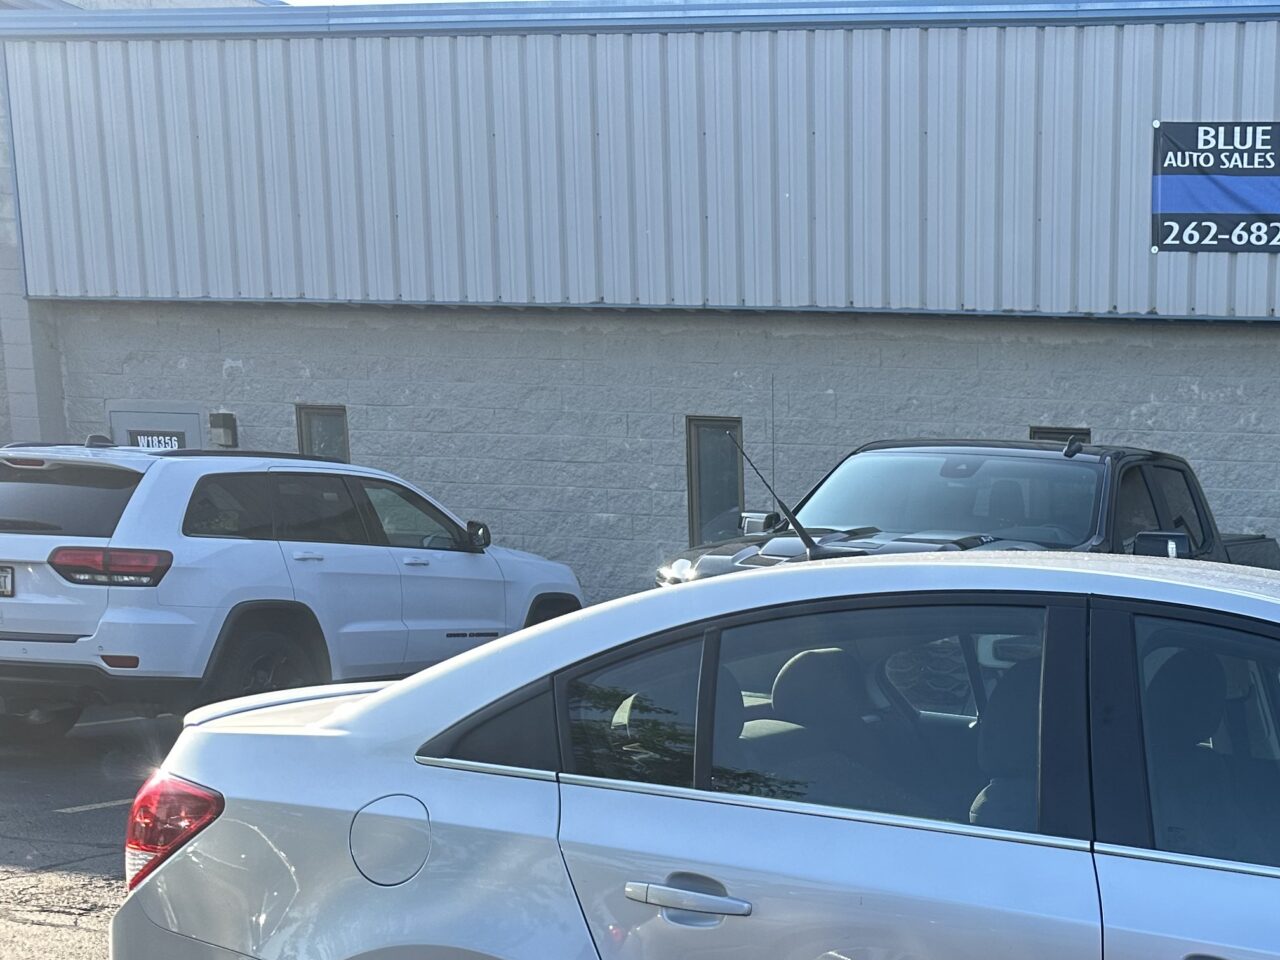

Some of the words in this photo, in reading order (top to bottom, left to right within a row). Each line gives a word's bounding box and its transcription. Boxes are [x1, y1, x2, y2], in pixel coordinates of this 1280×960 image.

[1197, 126, 1272, 150] BLUE
[1163, 151, 1215, 168] AUTO
[1219, 152, 1275, 169] SALES
[137, 435, 178, 450] W18356
